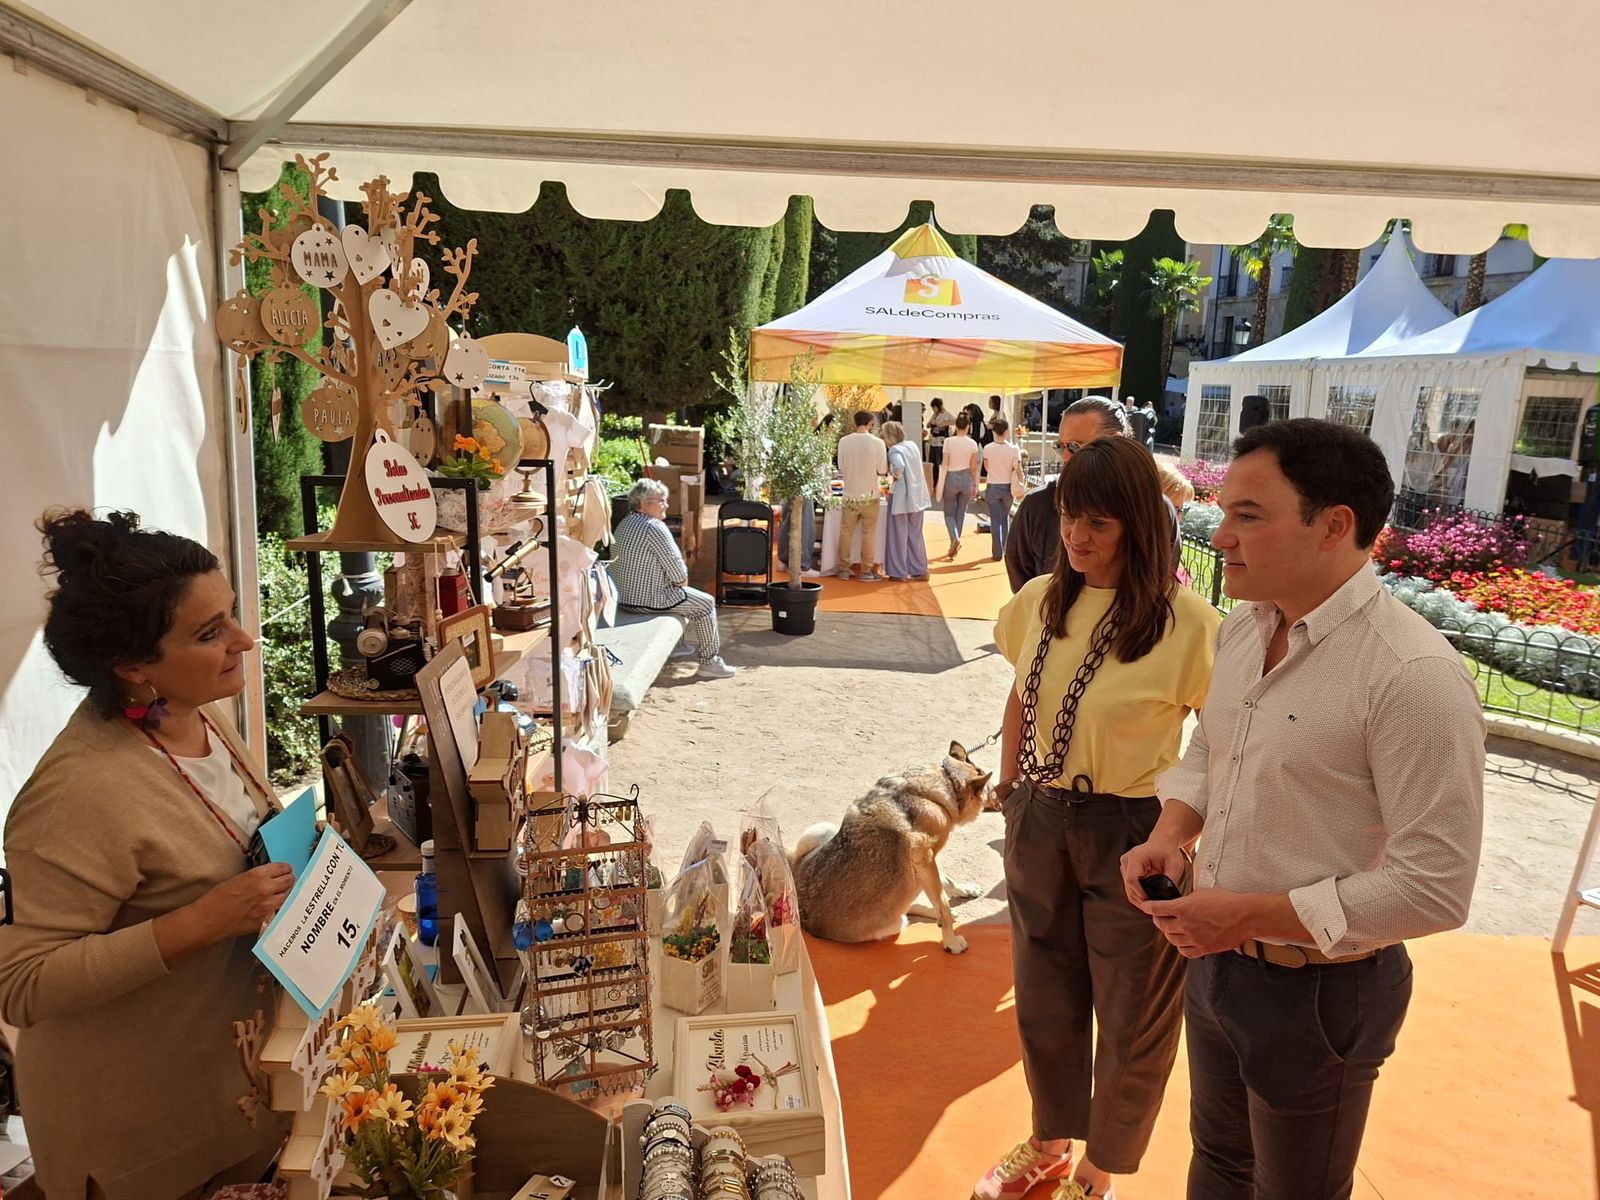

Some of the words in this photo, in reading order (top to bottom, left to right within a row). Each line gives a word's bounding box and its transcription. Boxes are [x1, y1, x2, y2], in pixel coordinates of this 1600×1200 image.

[303, 250, 338, 268] MAMA
[271, 309, 308, 326] ALICIA
[864, 306, 1000, 321] SALdeCompras
[313, 407, 352, 425] PAULA
[383, 459, 408, 478] Bolas
[279, 926, 302, 958] HACEMOS
[300, 914, 309, 926] LA
[305, 875, 331, 916] ESTRELLA
[326, 851, 340, 875] CON
[300, 901, 335, 954] NOMBRE
